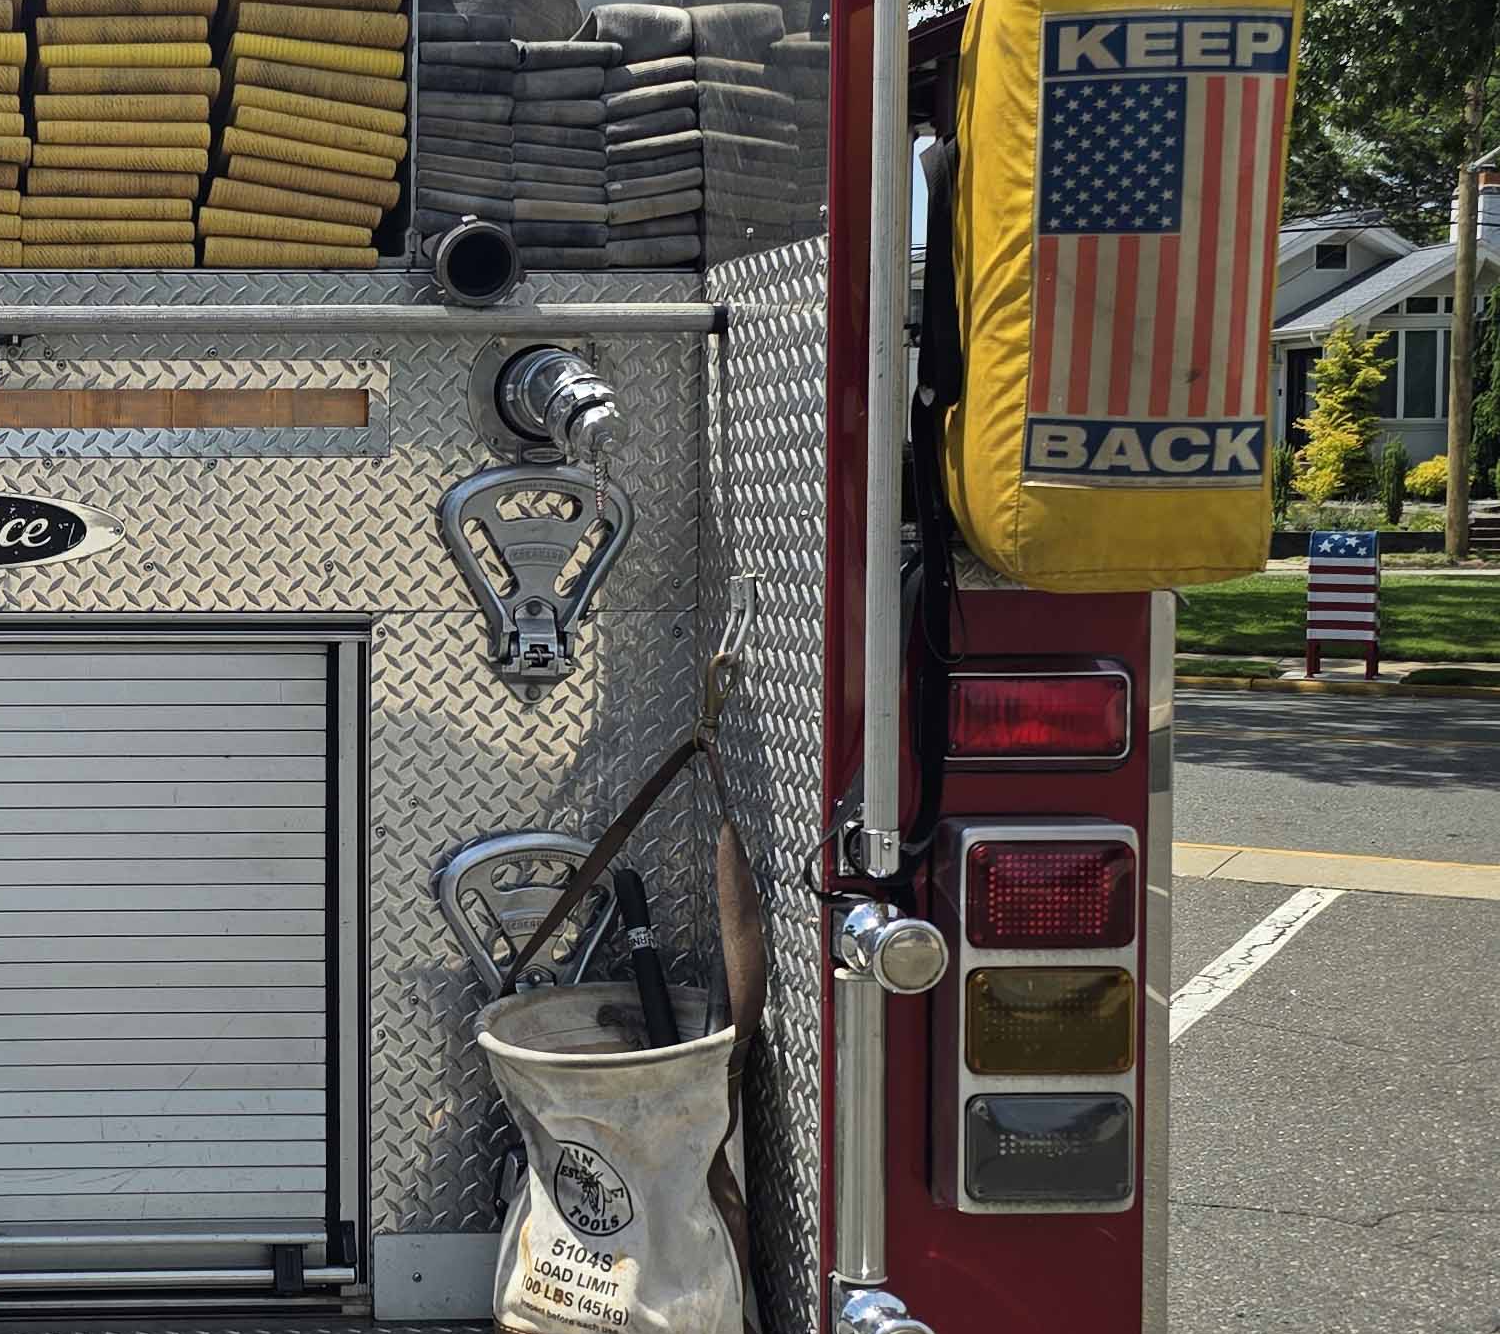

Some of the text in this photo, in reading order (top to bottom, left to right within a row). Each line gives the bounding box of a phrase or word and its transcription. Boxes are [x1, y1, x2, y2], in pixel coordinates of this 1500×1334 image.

[1057, 21, 1284, 72] KEEP
[1028, 423, 1263, 473] BACK
[569, 1205, 620, 1231] TOOLS
[534, 1257, 619, 1297] LOAD LIMIT
[543, 1283, 574, 1307] LBS
[578, 1295, 629, 1326] (45kg)
[546, 1309, 575, 1326] before
